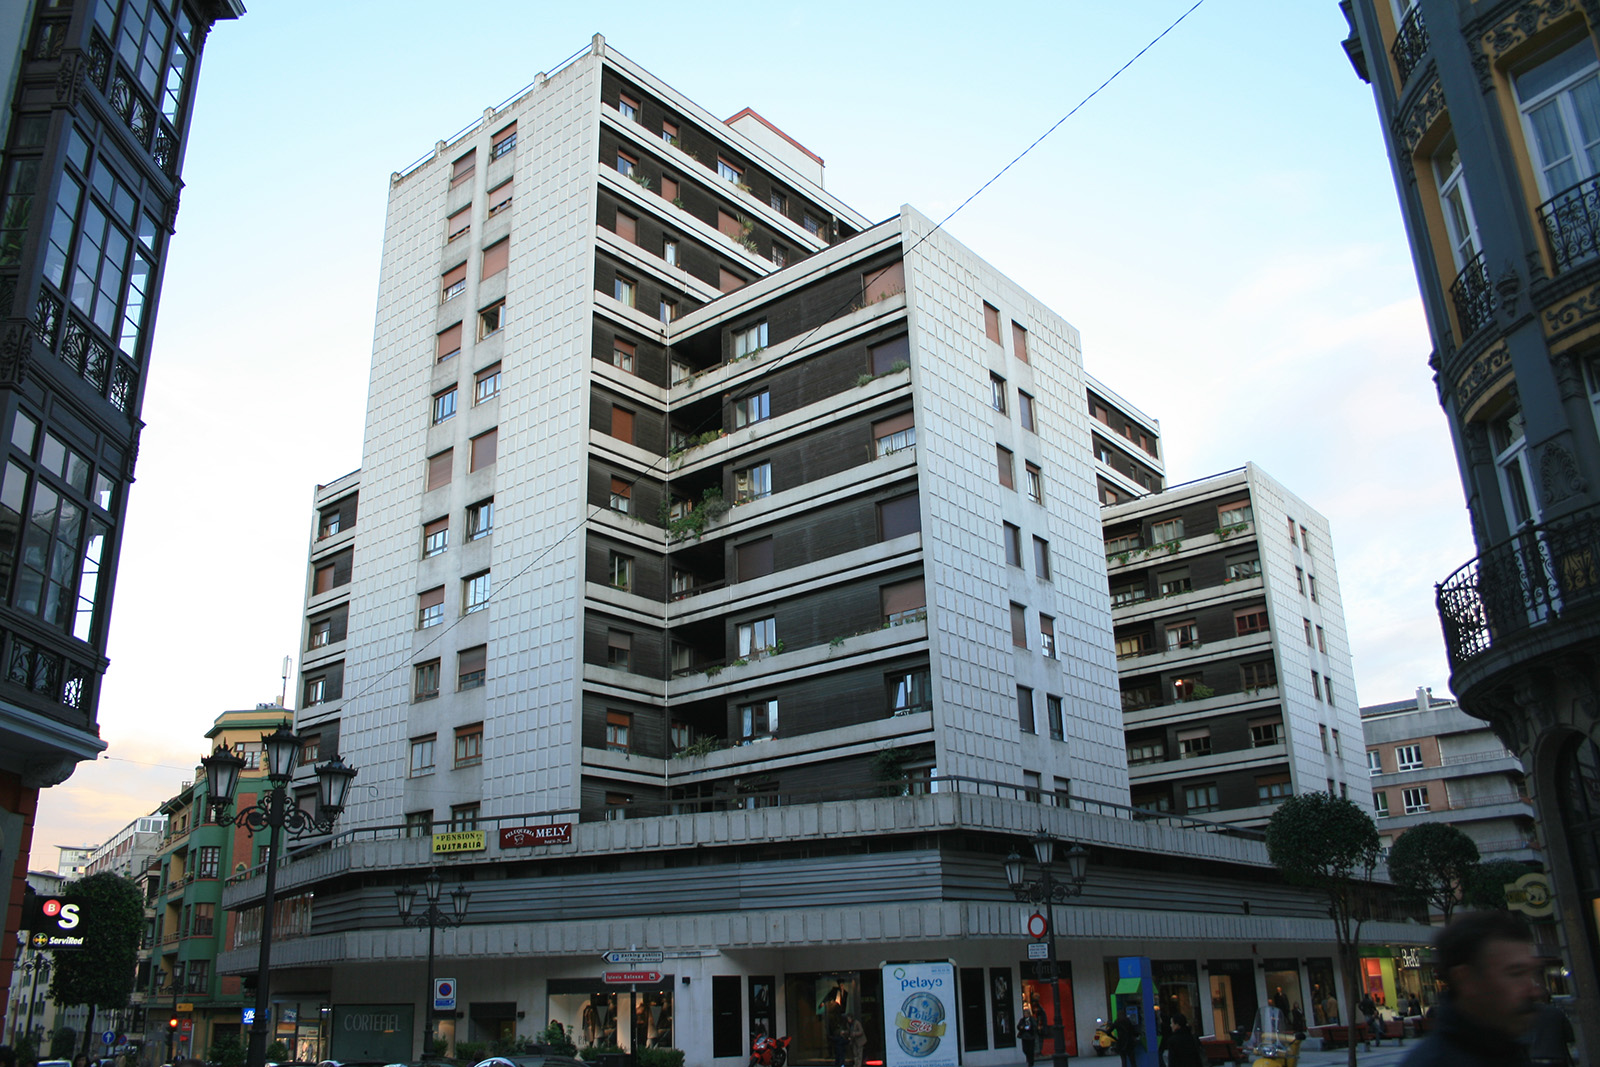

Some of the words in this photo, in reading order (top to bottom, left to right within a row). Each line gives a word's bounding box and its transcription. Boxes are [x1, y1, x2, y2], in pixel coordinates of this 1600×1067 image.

[441, 832, 475, 841] PENSION
[536, 824, 569, 838] MELY
[436, 841, 481, 851] AUSTRALIA
[48, 936, 84, 945] ServiRed
[901, 976, 943, 991] pelayo
[344, 1013, 401, 1032] CORTEFIEL
[906, 1019, 933, 1033] Sin
